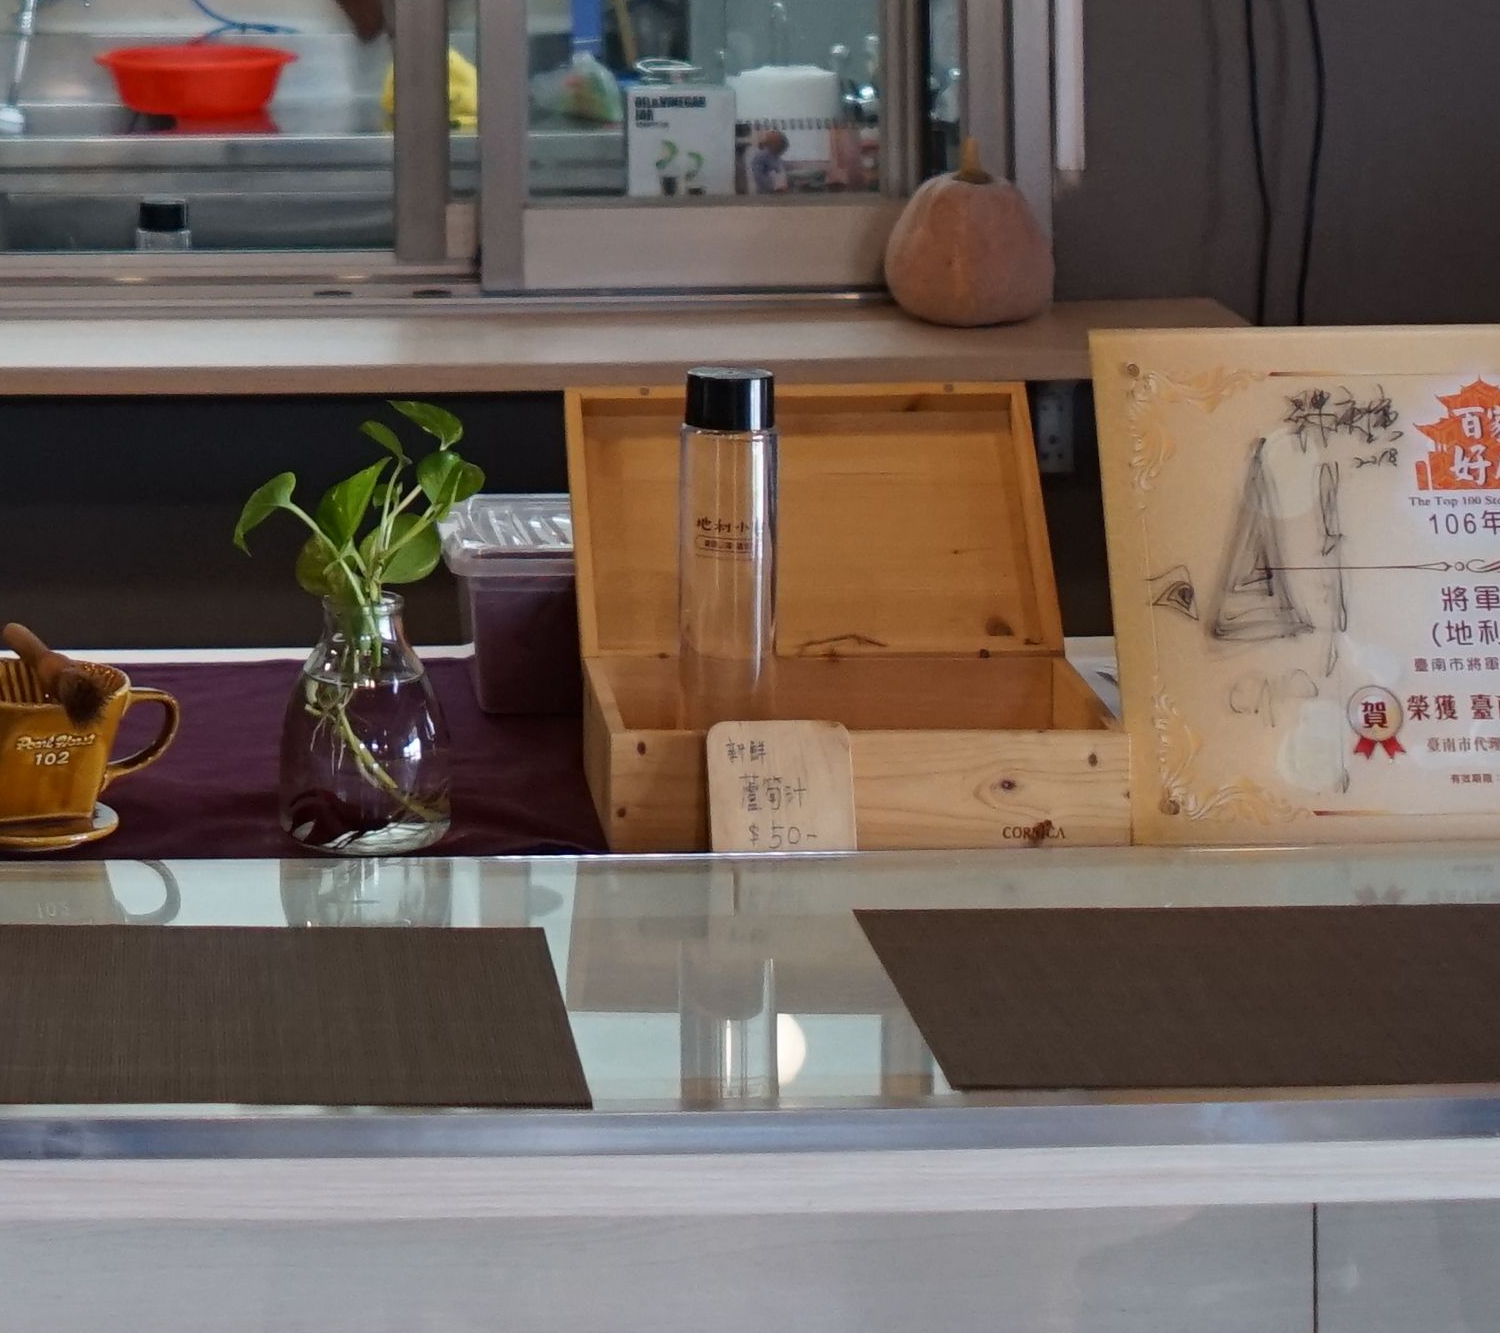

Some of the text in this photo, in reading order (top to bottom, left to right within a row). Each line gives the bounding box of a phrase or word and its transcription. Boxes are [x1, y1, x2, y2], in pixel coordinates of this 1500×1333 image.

[1408, 496, 1431, 506] The
[1434, 496, 1458, 508] Top
[35, 750, 70, 766] 102
